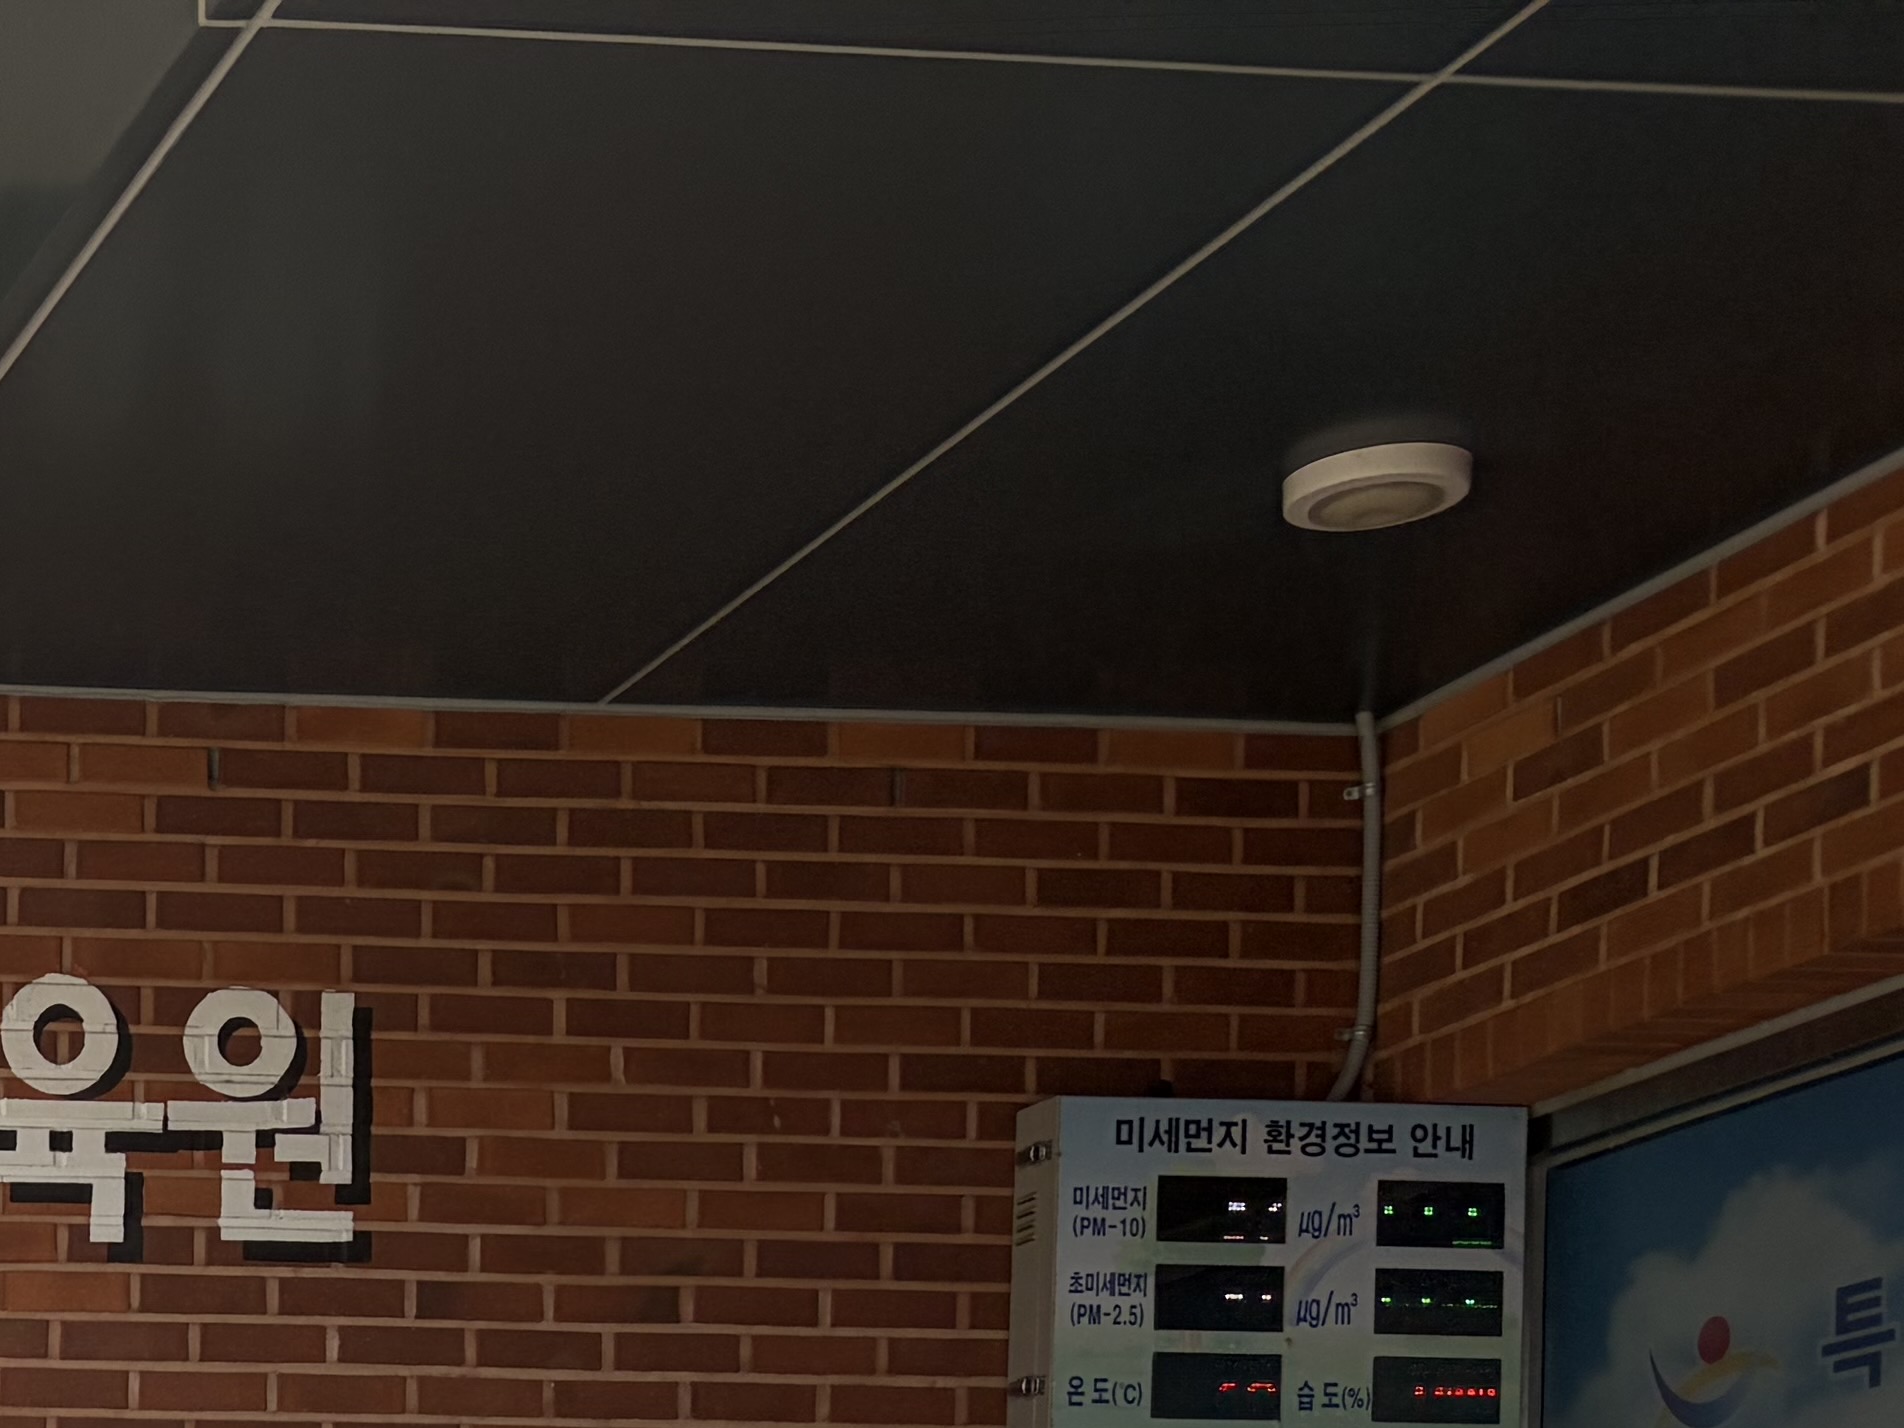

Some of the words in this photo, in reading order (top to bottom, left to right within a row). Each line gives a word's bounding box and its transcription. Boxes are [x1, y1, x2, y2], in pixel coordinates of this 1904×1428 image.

[1116, 1117, 1247, 1154] 미세먼지
[1264, 1120, 1396, 1157] 환경정보
[1411, 1123, 1474, 1160] 안내
[1073, 1186, 1147, 1211] 미세먼지
[1073, 1215, 1146, 1239] (PM-10)
[1069, 1272, 1147, 1297] 초미세먼지
[1070, 1303, 1144, 1328] (PM-2.5)
[1822, 1277, 1895, 1388] 특
